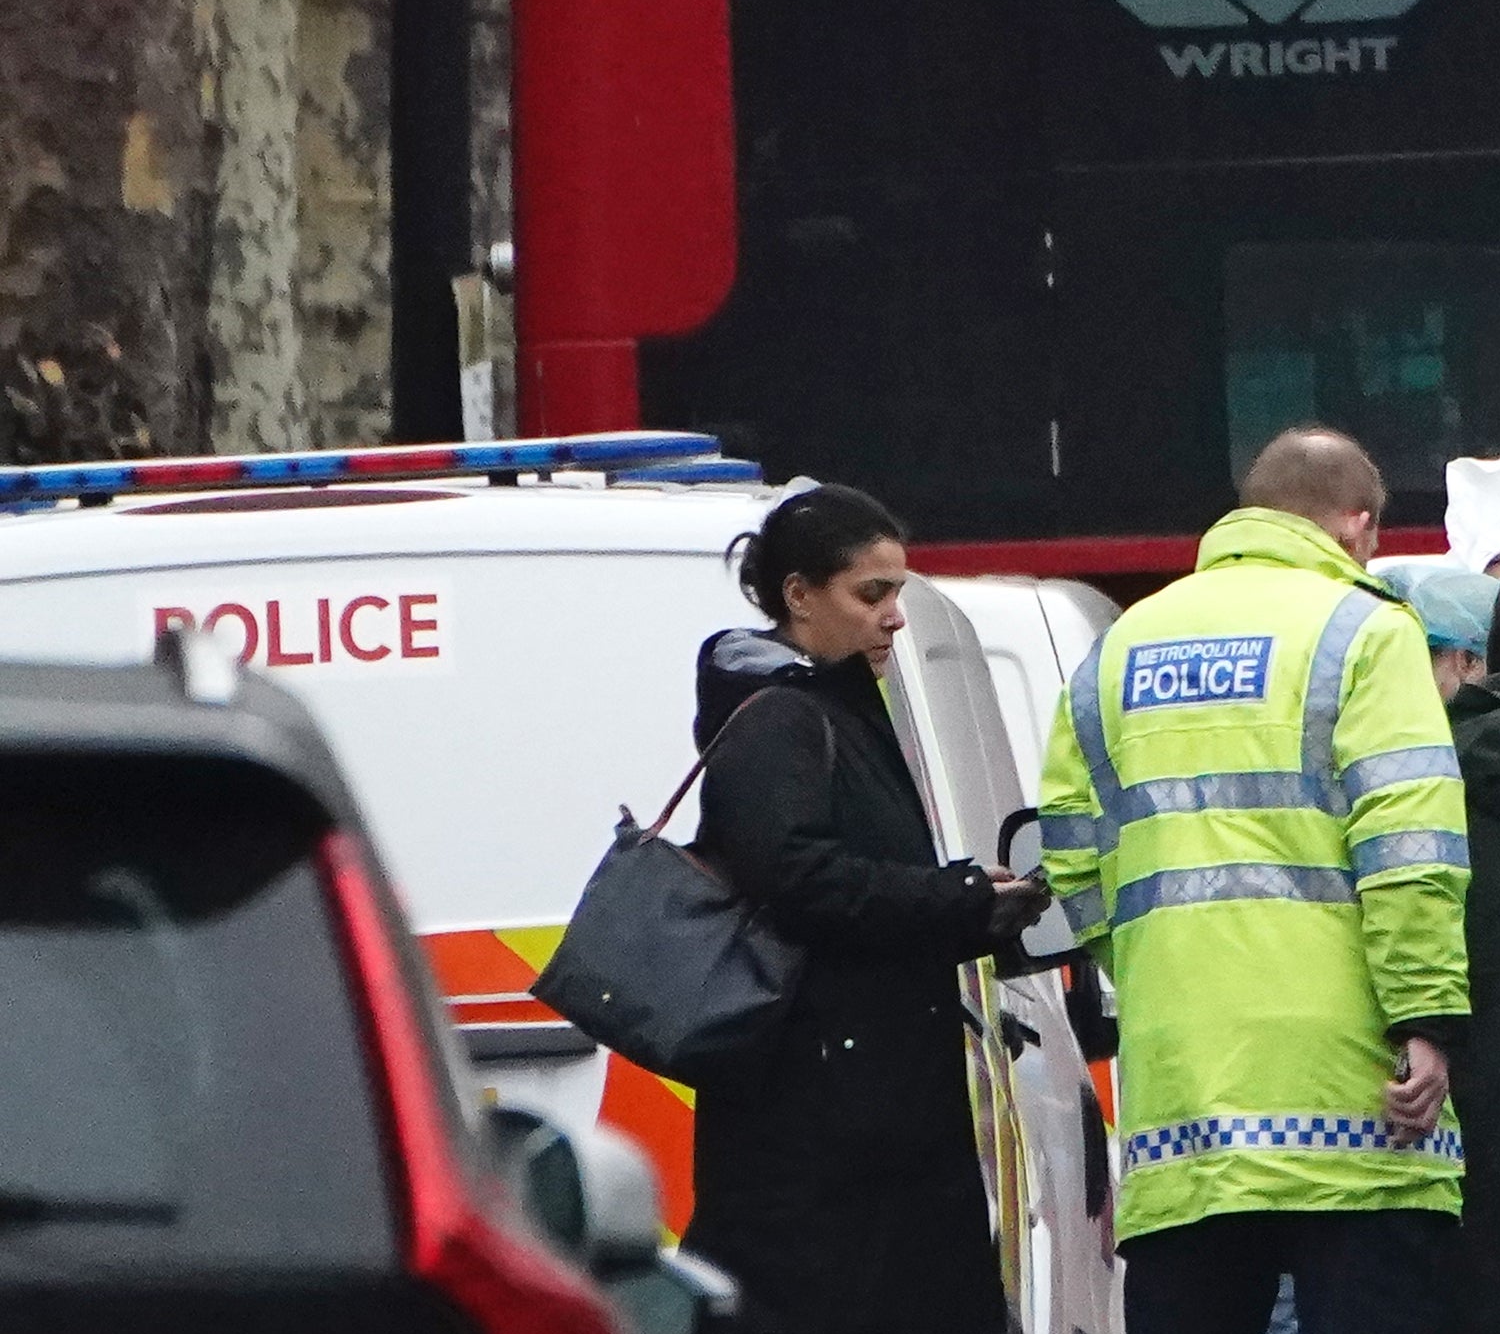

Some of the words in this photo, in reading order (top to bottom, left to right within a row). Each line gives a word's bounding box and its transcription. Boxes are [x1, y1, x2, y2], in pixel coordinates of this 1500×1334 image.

[1160, 38, 1399, 78] WRIGHT
[1135, 640, 1263, 667] METROPOLITAN
[1132, 660, 1258, 702] POLICE
